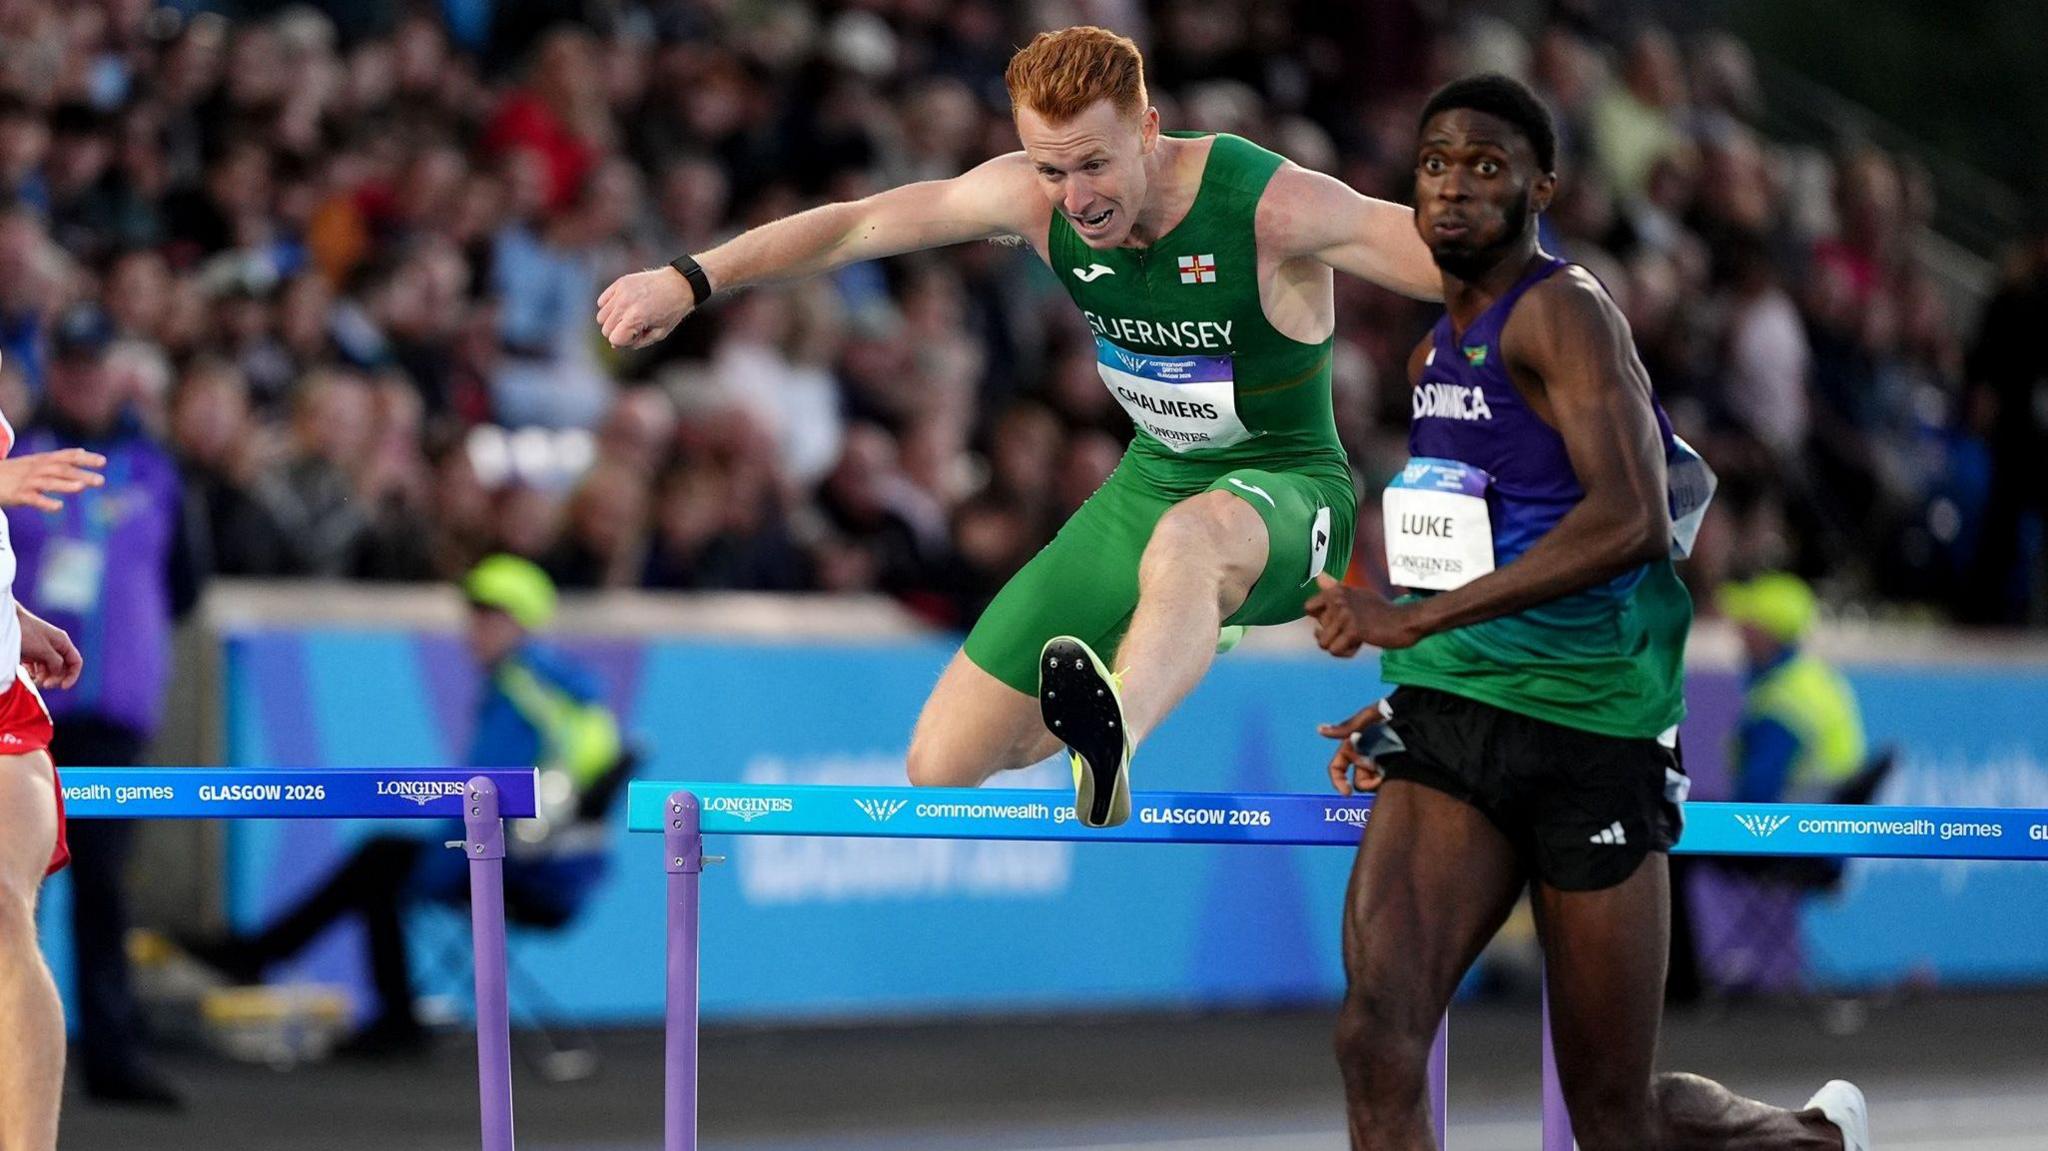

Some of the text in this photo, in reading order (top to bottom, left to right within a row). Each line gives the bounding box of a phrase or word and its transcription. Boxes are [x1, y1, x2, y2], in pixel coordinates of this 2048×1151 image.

[1117, 386, 1218, 420] CHALMERS
[1143, 420, 1211, 442] LONGINES
[1402, 512, 1453, 538] LUKE
[115, 786, 174, 804] games
[199, 785, 326, 801] GLASGOW 2026
[377, 781, 464, 795] LONGINES
[703, 797, 793, 812] LONGINES
[916, 803, 1079, 824] commonwealth ga
[1140, 808, 1271, 826] GLASGOW 2026
[1798, 819, 2002, 840] commonwealth games
